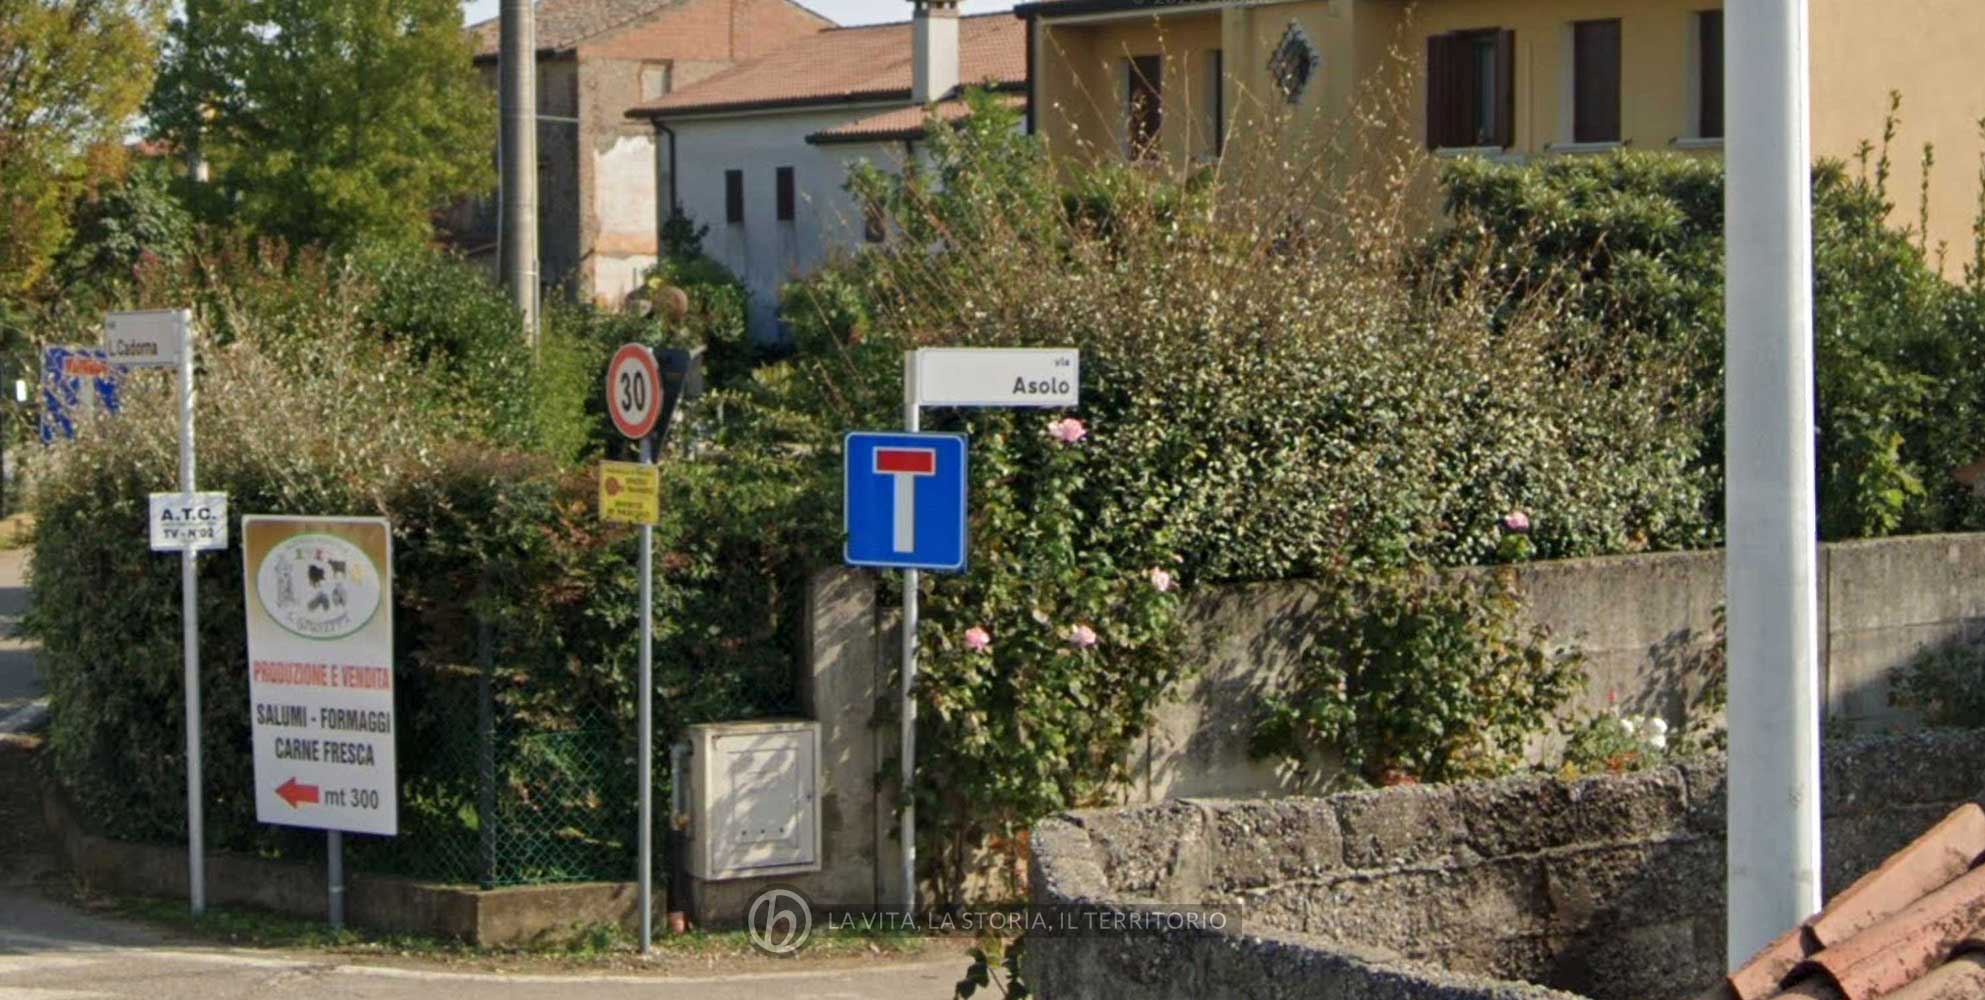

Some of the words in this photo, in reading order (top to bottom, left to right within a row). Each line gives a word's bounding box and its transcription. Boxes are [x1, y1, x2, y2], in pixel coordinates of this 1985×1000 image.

[1054, 357, 1070, 367] via
[620, 371, 646, 412] 30
[1012, 376, 1070, 395] Asolo
[160, 507, 217, 521] A.T.C.
[253, 660, 327, 686] PRODUZIONE
[330, 664, 338, 687] E
[342, 665, 390, 690] VENDITA
[256, 703, 307, 728] SALUMI
[320, 707, 391, 734] FORMAGGI
[274, 737, 319, 761] CARNE
[323, 740, 375, 767] FRESCA
[324, 788, 346, 807] mt
[351, 787, 379, 810] 300
